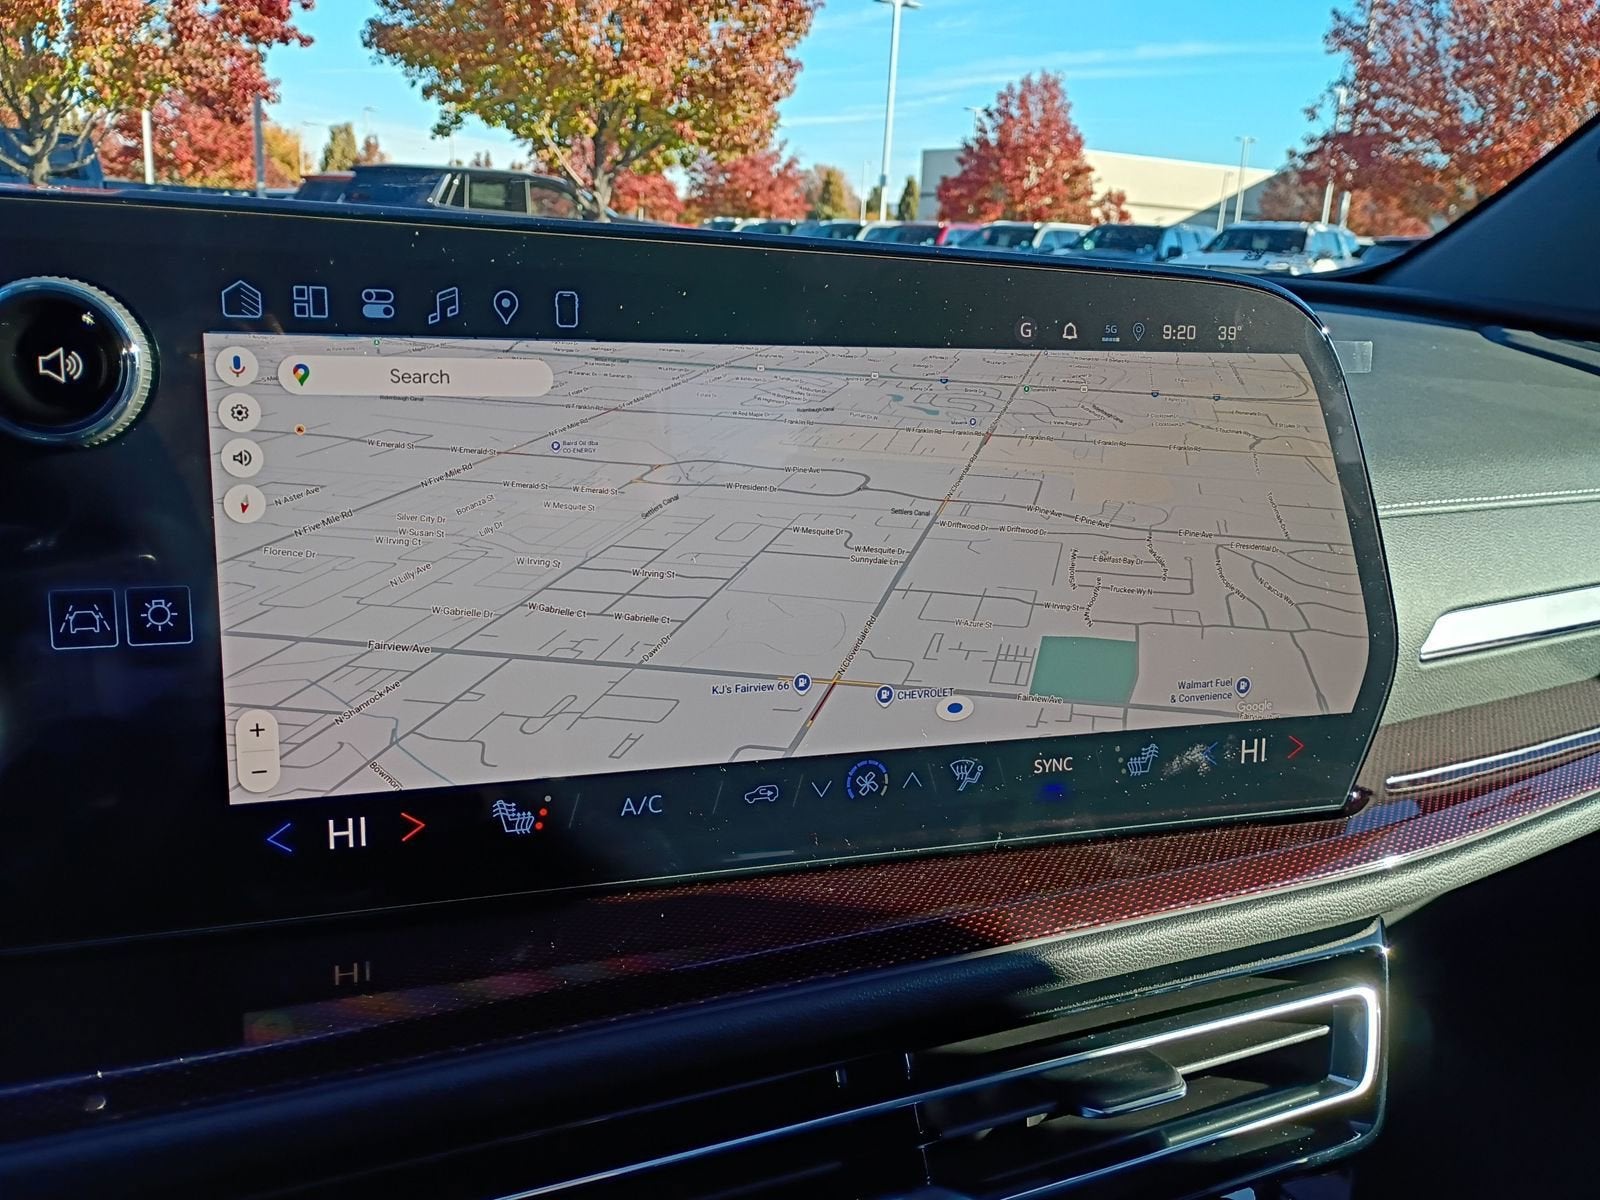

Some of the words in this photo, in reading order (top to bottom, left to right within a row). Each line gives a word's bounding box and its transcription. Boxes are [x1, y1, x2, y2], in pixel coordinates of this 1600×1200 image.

[1020, 323, 1032, 337] G
[1105, 325, 1117, 334] 5G
[1162, 325, 1196, 340] 9:20
[390, 368, 450, 384] Search
[376, 441, 405, 450] Emerald
[459, 447, 487, 456] Emerald
[421, 480, 429, 488] N
[429, 475, 444, 485] Five
[445, 468, 462, 480] Mile
[462, 463, 473, 473] Rd
[581, 487, 609, 495] Emerald
[735, 483, 768, 492] President
[274, 499, 282, 507] N
[283, 492, 304, 504] Aster
[305, 487, 320, 498] Ave
[456, 497, 487, 516] Bonanza
[487, 494, 495, 502] St
[553, 502, 587, 512] Mesquite
[587, 504, 595, 512] St
[294, 529, 303, 538] N
[303, 522, 321, 534] Five
[321, 515, 341, 527] Mile
[341, 509, 354, 520] Rd
[397, 513, 418, 522] Silver
[420, 515, 436, 524] City
[1081, 516, 1095, 526] Pine
[1096, 520, 1110, 528] Ave
[479, 526, 495, 538] Lilly
[494, 521, 504, 530] Dr
[948, 521, 979, 530] Driftwood
[408, 529, 435, 537] Susan
[802, 527, 834, 537] Mesquite
[1185, 530, 1199, 539] Pine
[386, 538, 410, 547] Irving
[1236, 543, 1271, 552] Presidential
[264, 547, 303, 558] Florence
[864, 546, 896, 556] Mesquite
[1070, 549, 1079, 560] Wy
[1148, 544, 1166, 568] Parkdale
[517, 557, 525, 565] W
[527, 558, 551, 569] Irving
[552, 561, 561, 569] St
[851, 555, 888, 566] Sunnydale
[1099, 556, 1121, 564] Belfast
[1122, 558, 1135, 566] Bay
[390, 579, 398, 588] N
[400, 571, 416, 584] Lilly
[416, 563, 432, 575] Ave
[642, 570, 665, 580] Irving
[666, 571, 675, 579] St
[1217, 567, 1235, 592] Principle
[1234, 589, 1247, 601] Way
[1110, 585, 1135, 594] Truckee
[1136, 589, 1147, 597] Wy
[1264, 581, 1284, 599] Caucus
[1283, 595, 1295, 607] Way
[1086, 591, 1098, 611] Hood
[443, 607, 482, 618] Gabrielle
[484, 611, 494, 619] Dr
[528, 602, 538, 611] W
[539, 604, 576, 618] Gabrielle
[577, 610, 586, 618] Ct
[1052, 604, 1071, 612] Irving
[624, 613, 659, 624] Gabrielle
[661, 616, 670, 624] Ct
[964, 620, 984, 628] Azure
[368, 640, 410, 652] Fairview
[412, 645, 431, 654] Ave
[642, 644, 663, 663] Dawn
[661, 635, 672, 646] Dr
[838, 668, 845, 676] N
[842, 628, 870, 669] Cloverdale
[867, 616, 877, 630] Rd
[712, 685, 732, 695] KJ's
[735, 683, 774, 694] Fairview
[777, 682, 790, 690] 66
[1178, 681, 1213, 690] Walmart
[1216, 678, 1233, 688] Fuel
[898, 688, 954, 701] CHEVROLET
[1018, 693, 1048, 703] Fairview
[1049, 695, 1064, 704] Ave
[1179, 692, 1233, 703] Convenience
[335, 718, 343, 726] N
[344, 690, 386, 720] Shamrock
[385, 681, 401, 695] Ave
[1237, 701, 1272, 712] Google
[1241, 738, 1266, 764] HI
[1034, 757, 1073, 774] SYNC
[621, 795, 663, 816] A/C
[329, 817, 366, 849] HI
